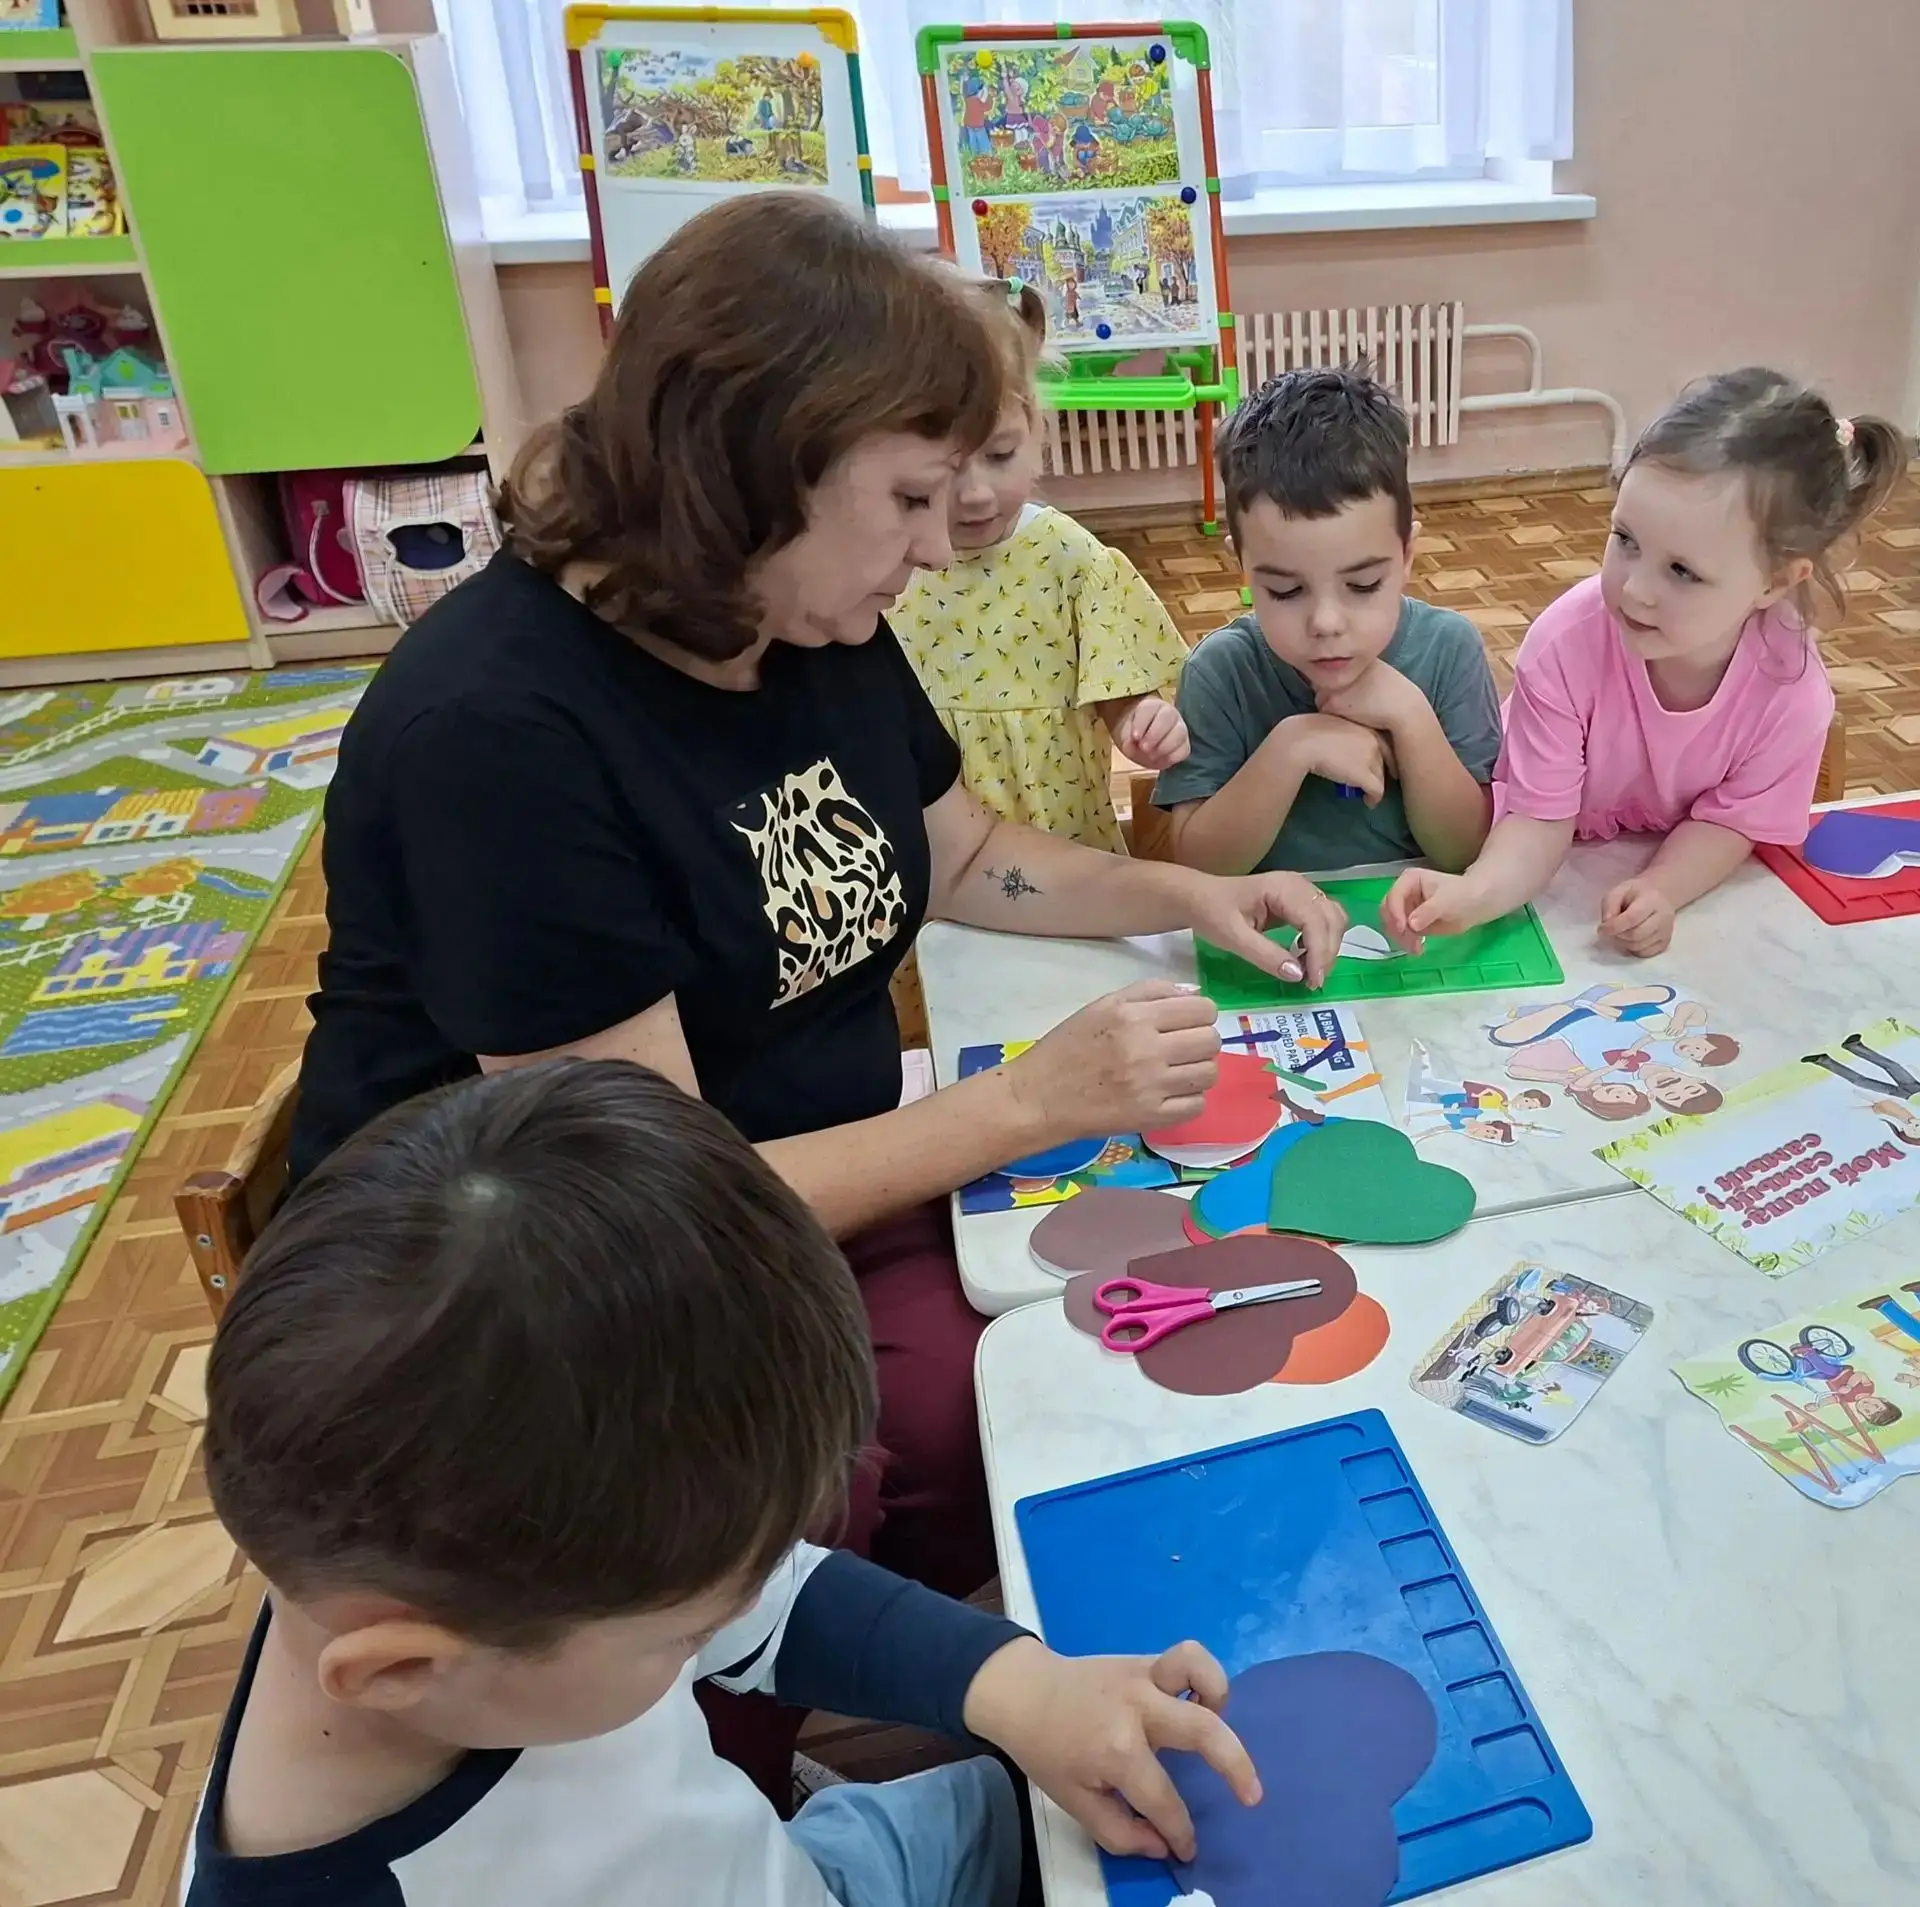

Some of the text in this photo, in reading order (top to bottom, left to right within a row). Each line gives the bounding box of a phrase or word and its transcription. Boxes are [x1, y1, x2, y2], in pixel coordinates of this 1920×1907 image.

[1287, 1048, 1301, 1071] PAPE
[1321, 1020, 1346, 1064] BRAURG
[1726, 1151, 1833, 1215] самый
[1829, 1141, 1906, 1186] Мой
